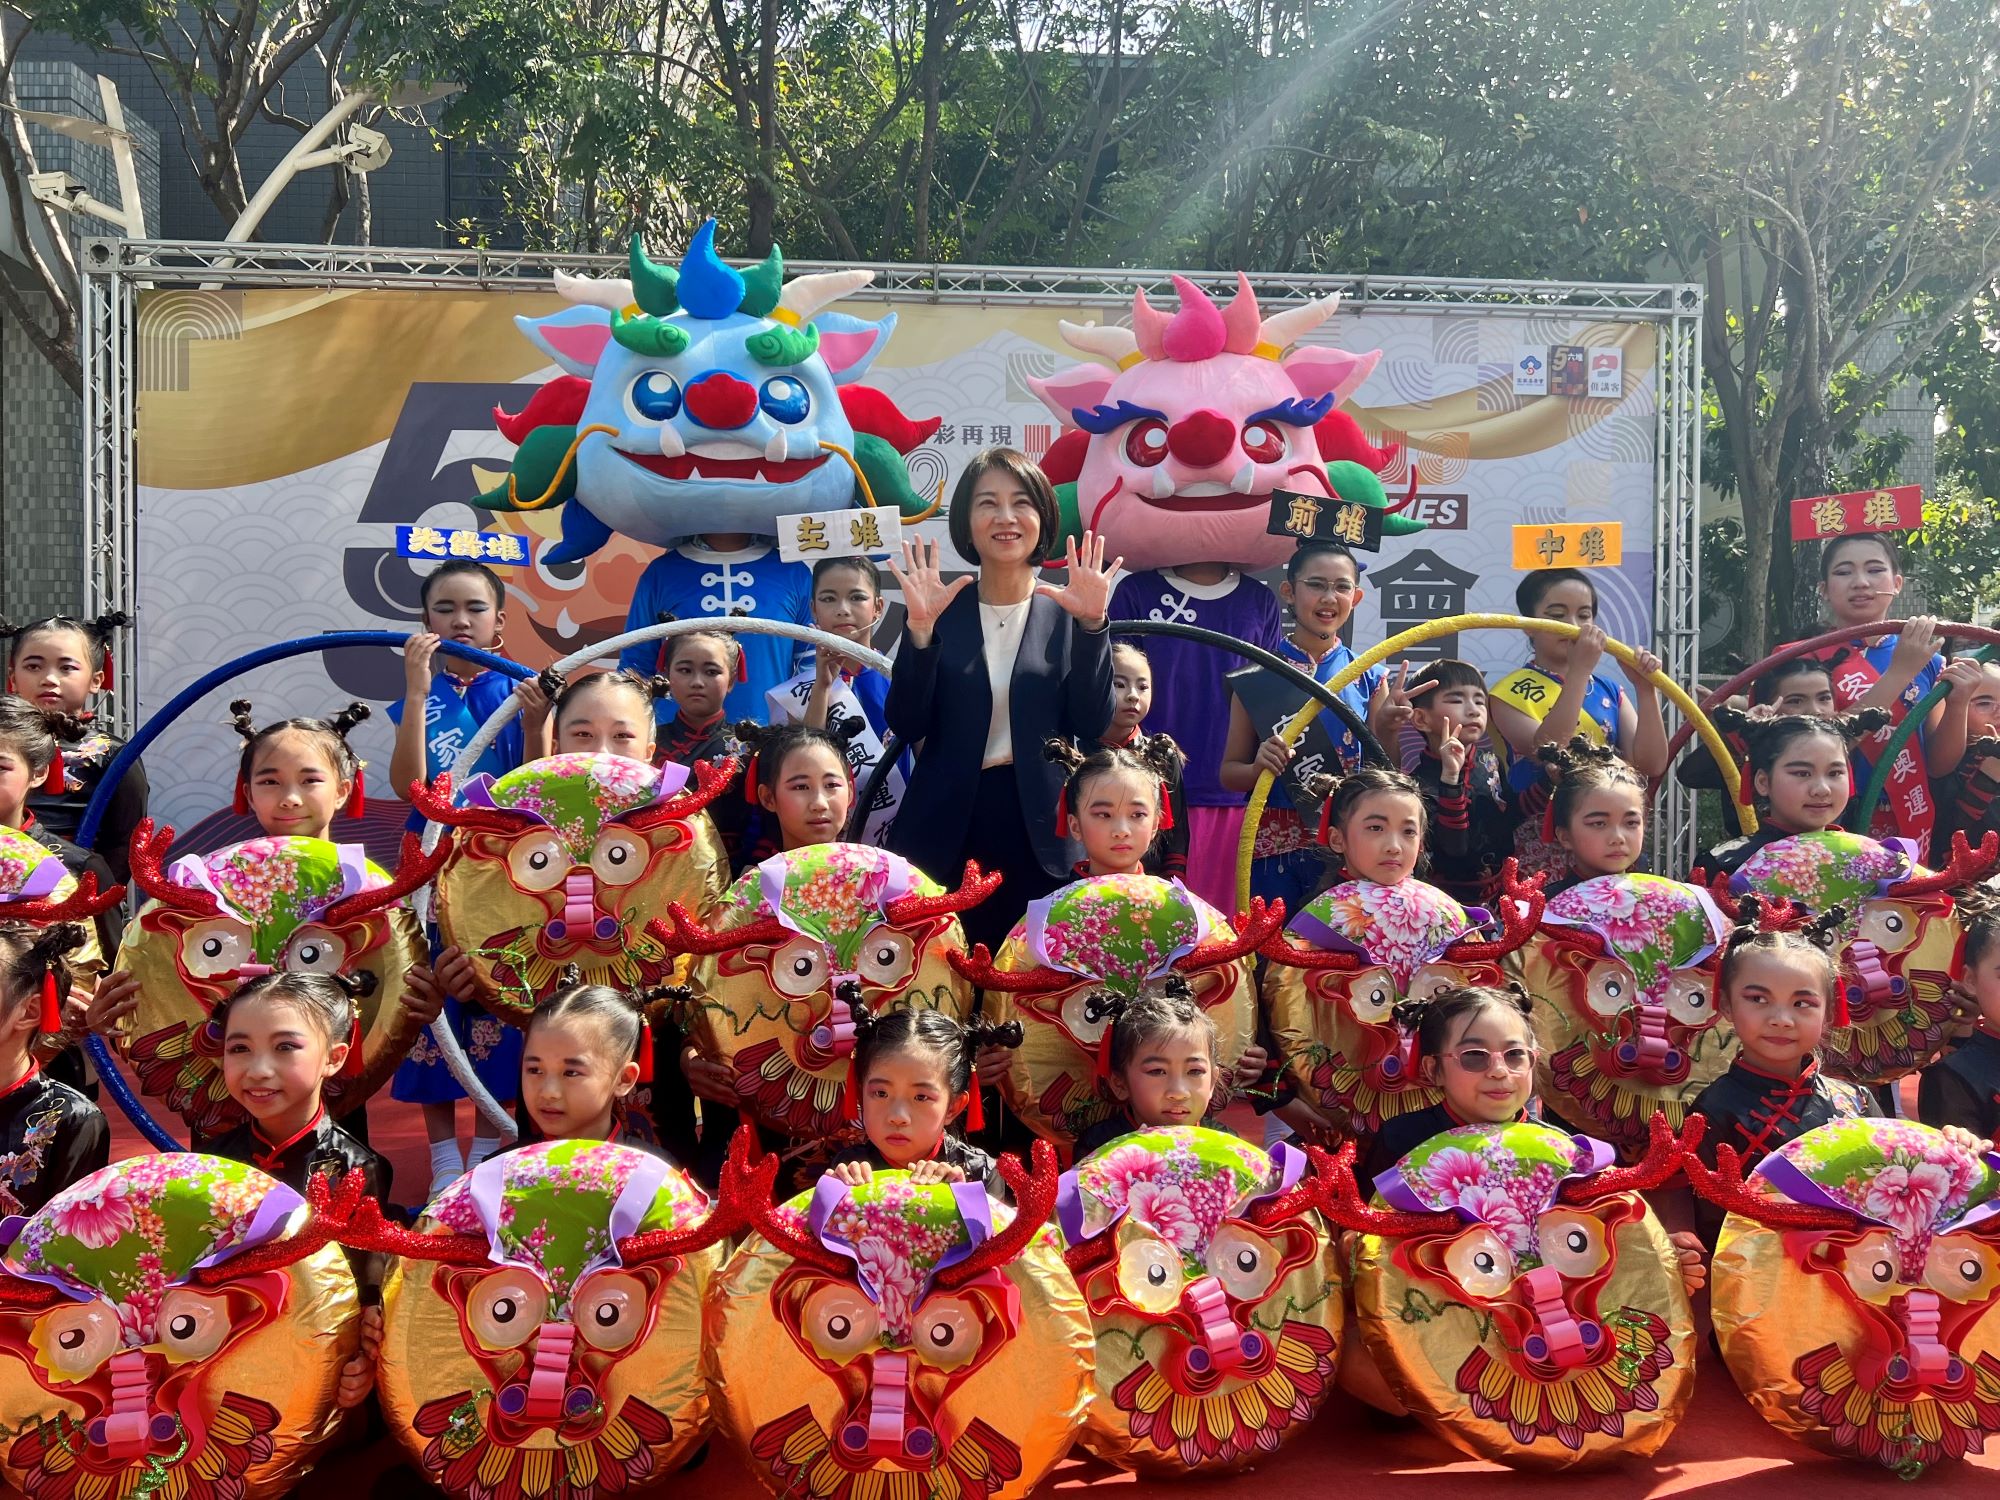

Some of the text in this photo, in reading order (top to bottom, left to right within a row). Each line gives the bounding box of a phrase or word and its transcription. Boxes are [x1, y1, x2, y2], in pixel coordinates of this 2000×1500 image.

[797, 512, 883, 551] 左堆
[1285, 496, 1367, 545] 前堆
[1810, 491, 1899, 535] 後堆
[408, 527, 525, 561] 先鋒堆
[1536, 527, 1605, 564] 中堆
